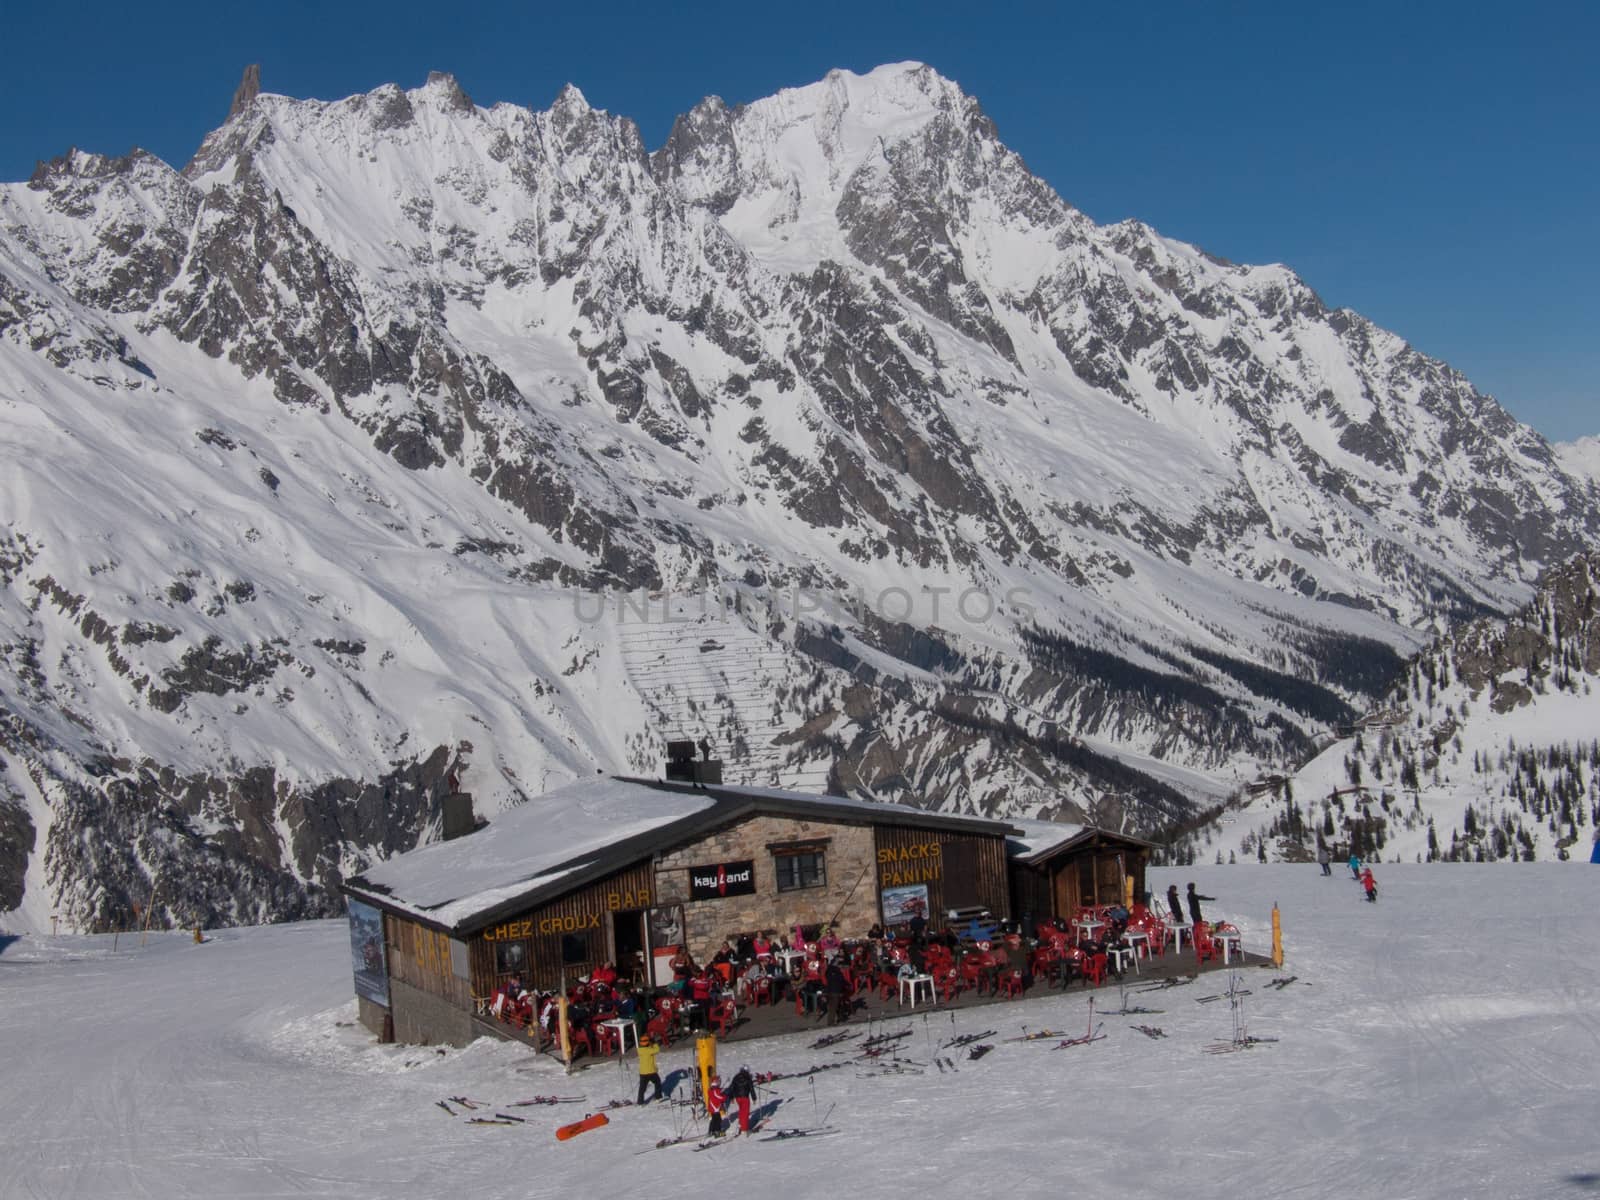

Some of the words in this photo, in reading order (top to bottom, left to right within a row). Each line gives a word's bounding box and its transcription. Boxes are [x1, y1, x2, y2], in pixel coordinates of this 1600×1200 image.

[878, 843, 941, 864] SNACKS
[882, 864, 941, 887] PANINI
[608, 889, 650, 911] BAR
[483, 921, 533, 941] CHEZ
[540, 913, 600, 936] CROUX
[415, 922, 452, 979] BAR
